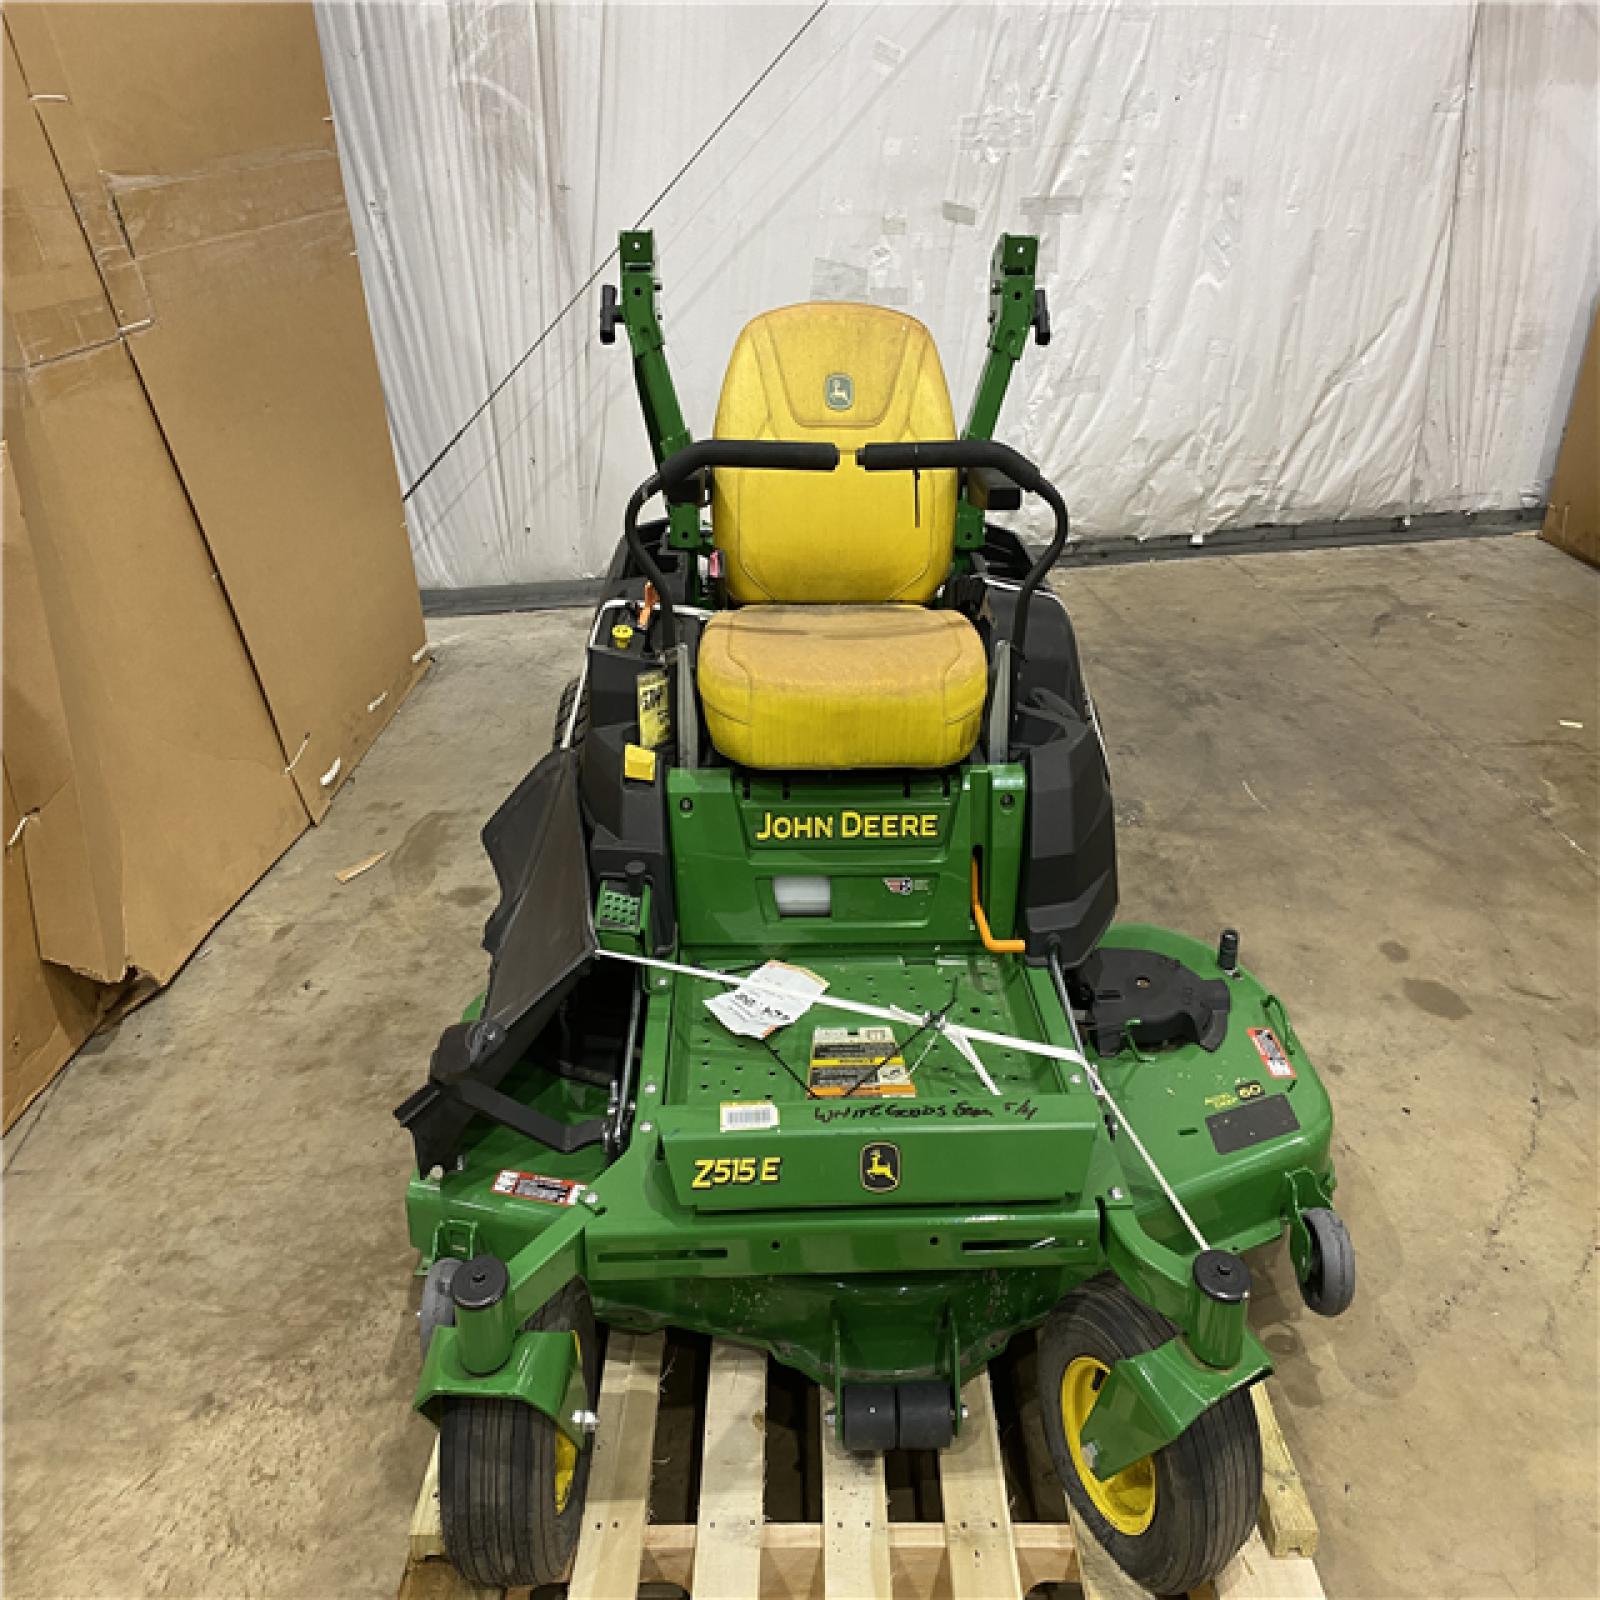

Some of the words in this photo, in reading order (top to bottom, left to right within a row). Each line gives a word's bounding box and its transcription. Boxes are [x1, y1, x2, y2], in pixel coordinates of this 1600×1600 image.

[755, 810, 834, 840] JOHN
[841, 809, 938, 838] DEERE
[691, 1157, 756, 1190] Z515
[760, 1156, 782, 1183] E
